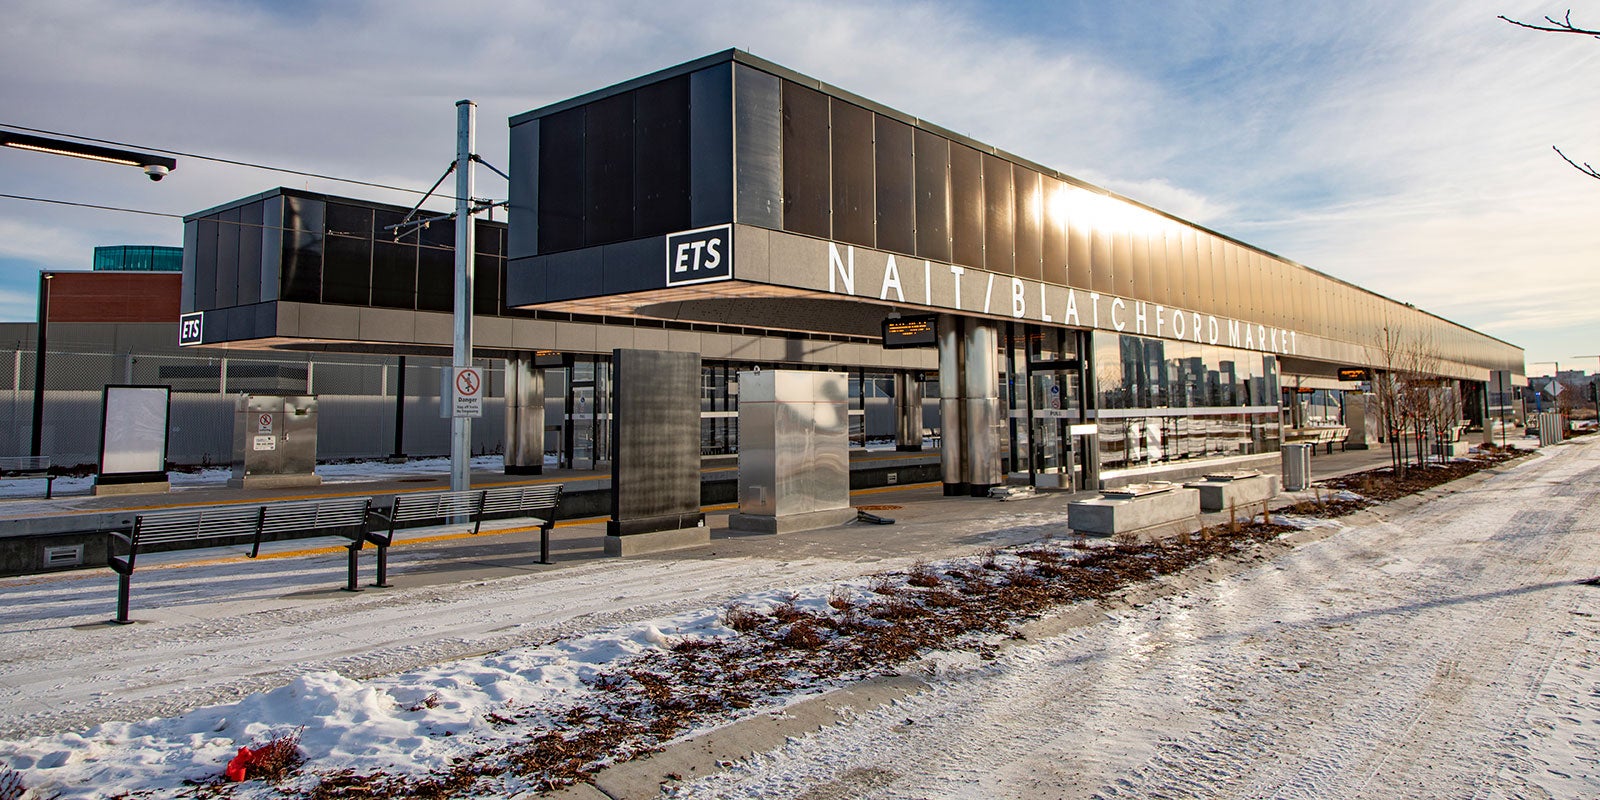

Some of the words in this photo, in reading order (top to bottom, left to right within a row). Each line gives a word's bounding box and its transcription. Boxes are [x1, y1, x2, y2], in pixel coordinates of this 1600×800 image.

[674, 237, 722, 273] ETS
[182, 319, 200, 338] ETS
[1227, 318, 1297, 355] MARKET
